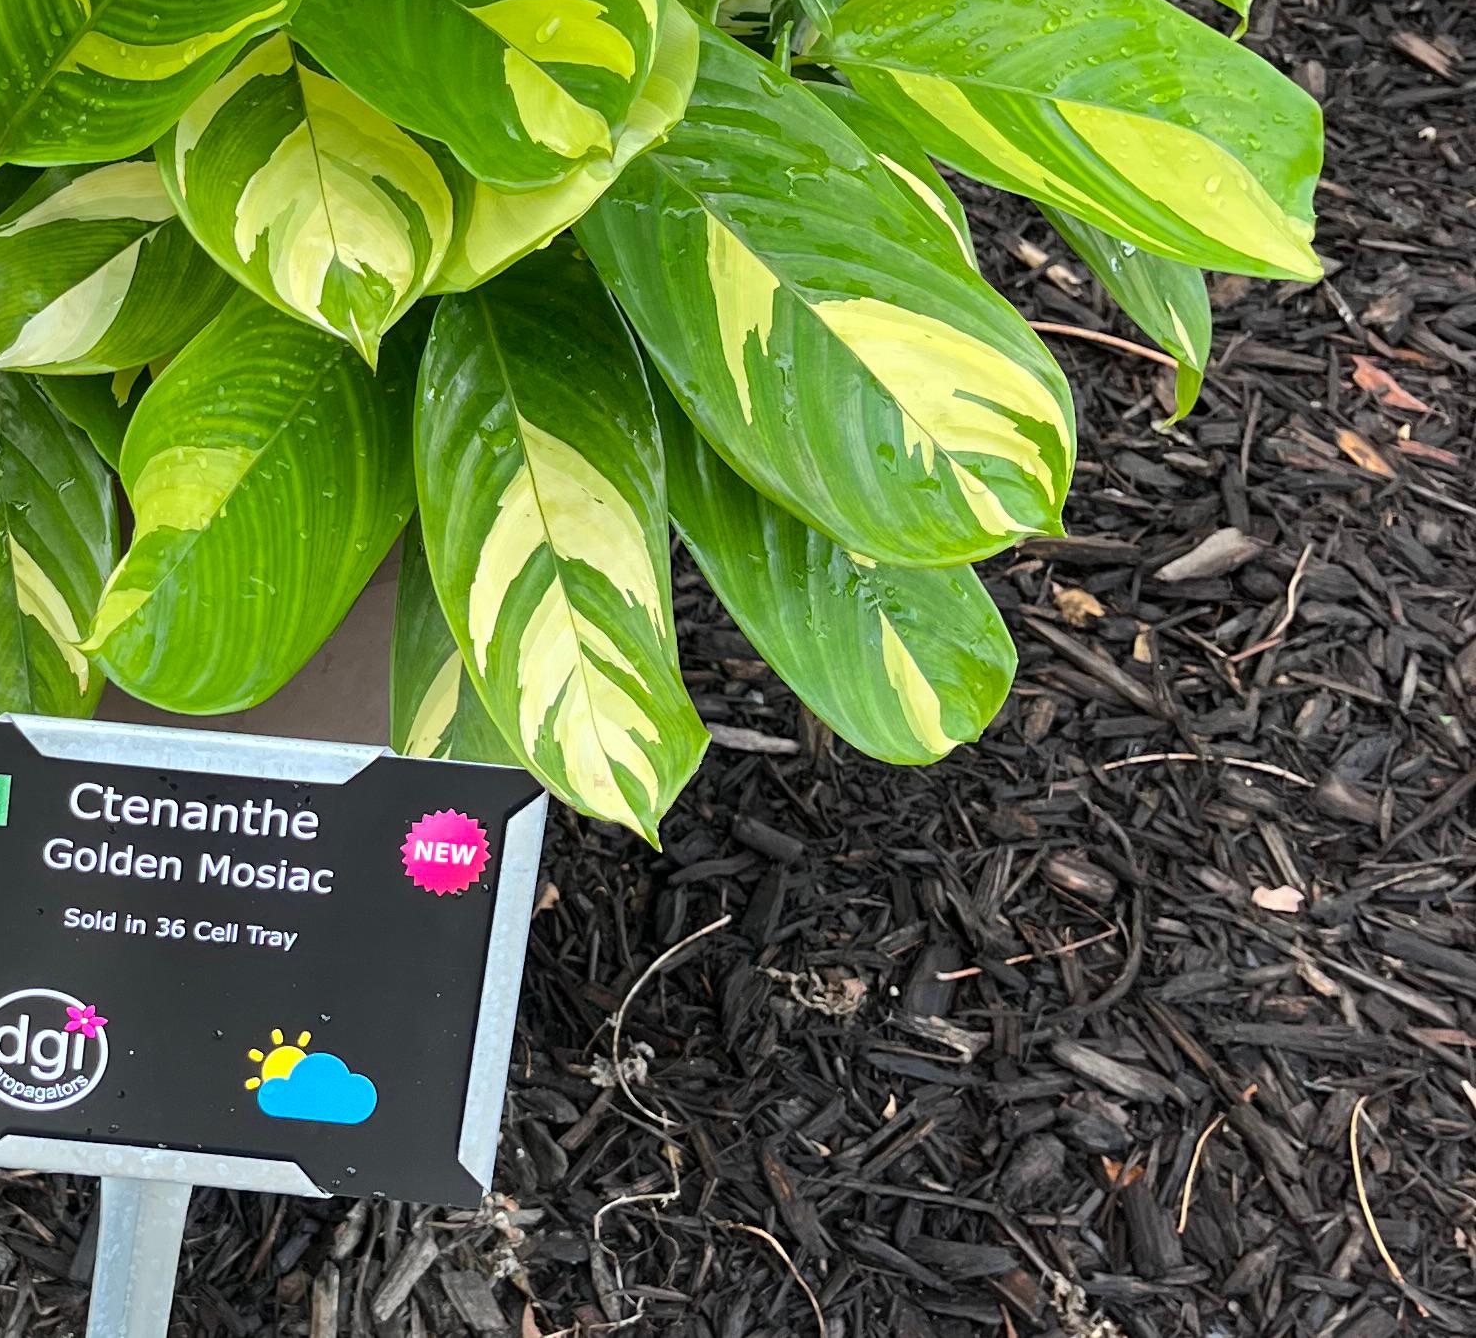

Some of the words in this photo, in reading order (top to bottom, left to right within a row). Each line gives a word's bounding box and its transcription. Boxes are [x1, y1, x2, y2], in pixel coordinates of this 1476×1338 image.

[68, 781, 321, 840] Ctenanthe
[42, 838, 183, 882] Golden
[199, 853, 335, 895] Mosiac
[413, 839, 478, 866] NEW
[63, 907, 117, 934] Sold
[124, 913, 148, 936] in
[155, 916, 186, 941] 36
[194, 920, 240, 945] Cell
[246, 924, 299, 952] Tray
